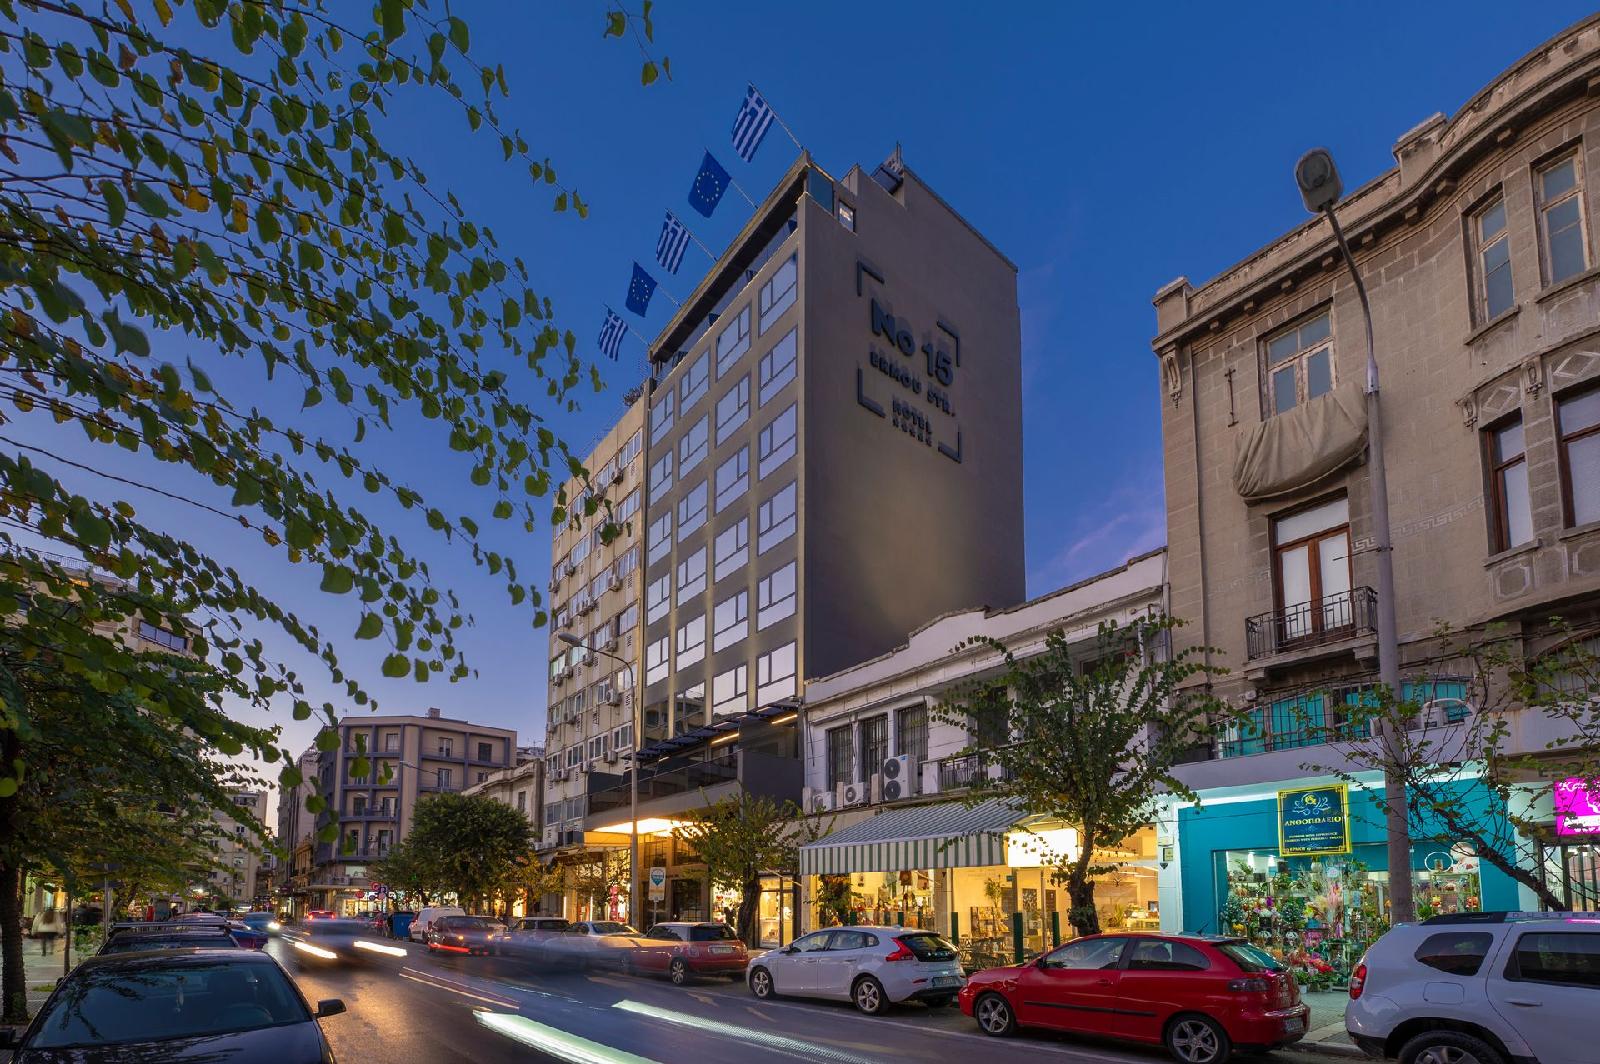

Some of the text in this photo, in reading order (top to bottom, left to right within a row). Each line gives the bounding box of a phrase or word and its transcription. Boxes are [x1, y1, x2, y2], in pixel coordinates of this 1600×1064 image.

[871, 297, 954, 387] No 15
[892, 398, 933, 436] HOTEL
